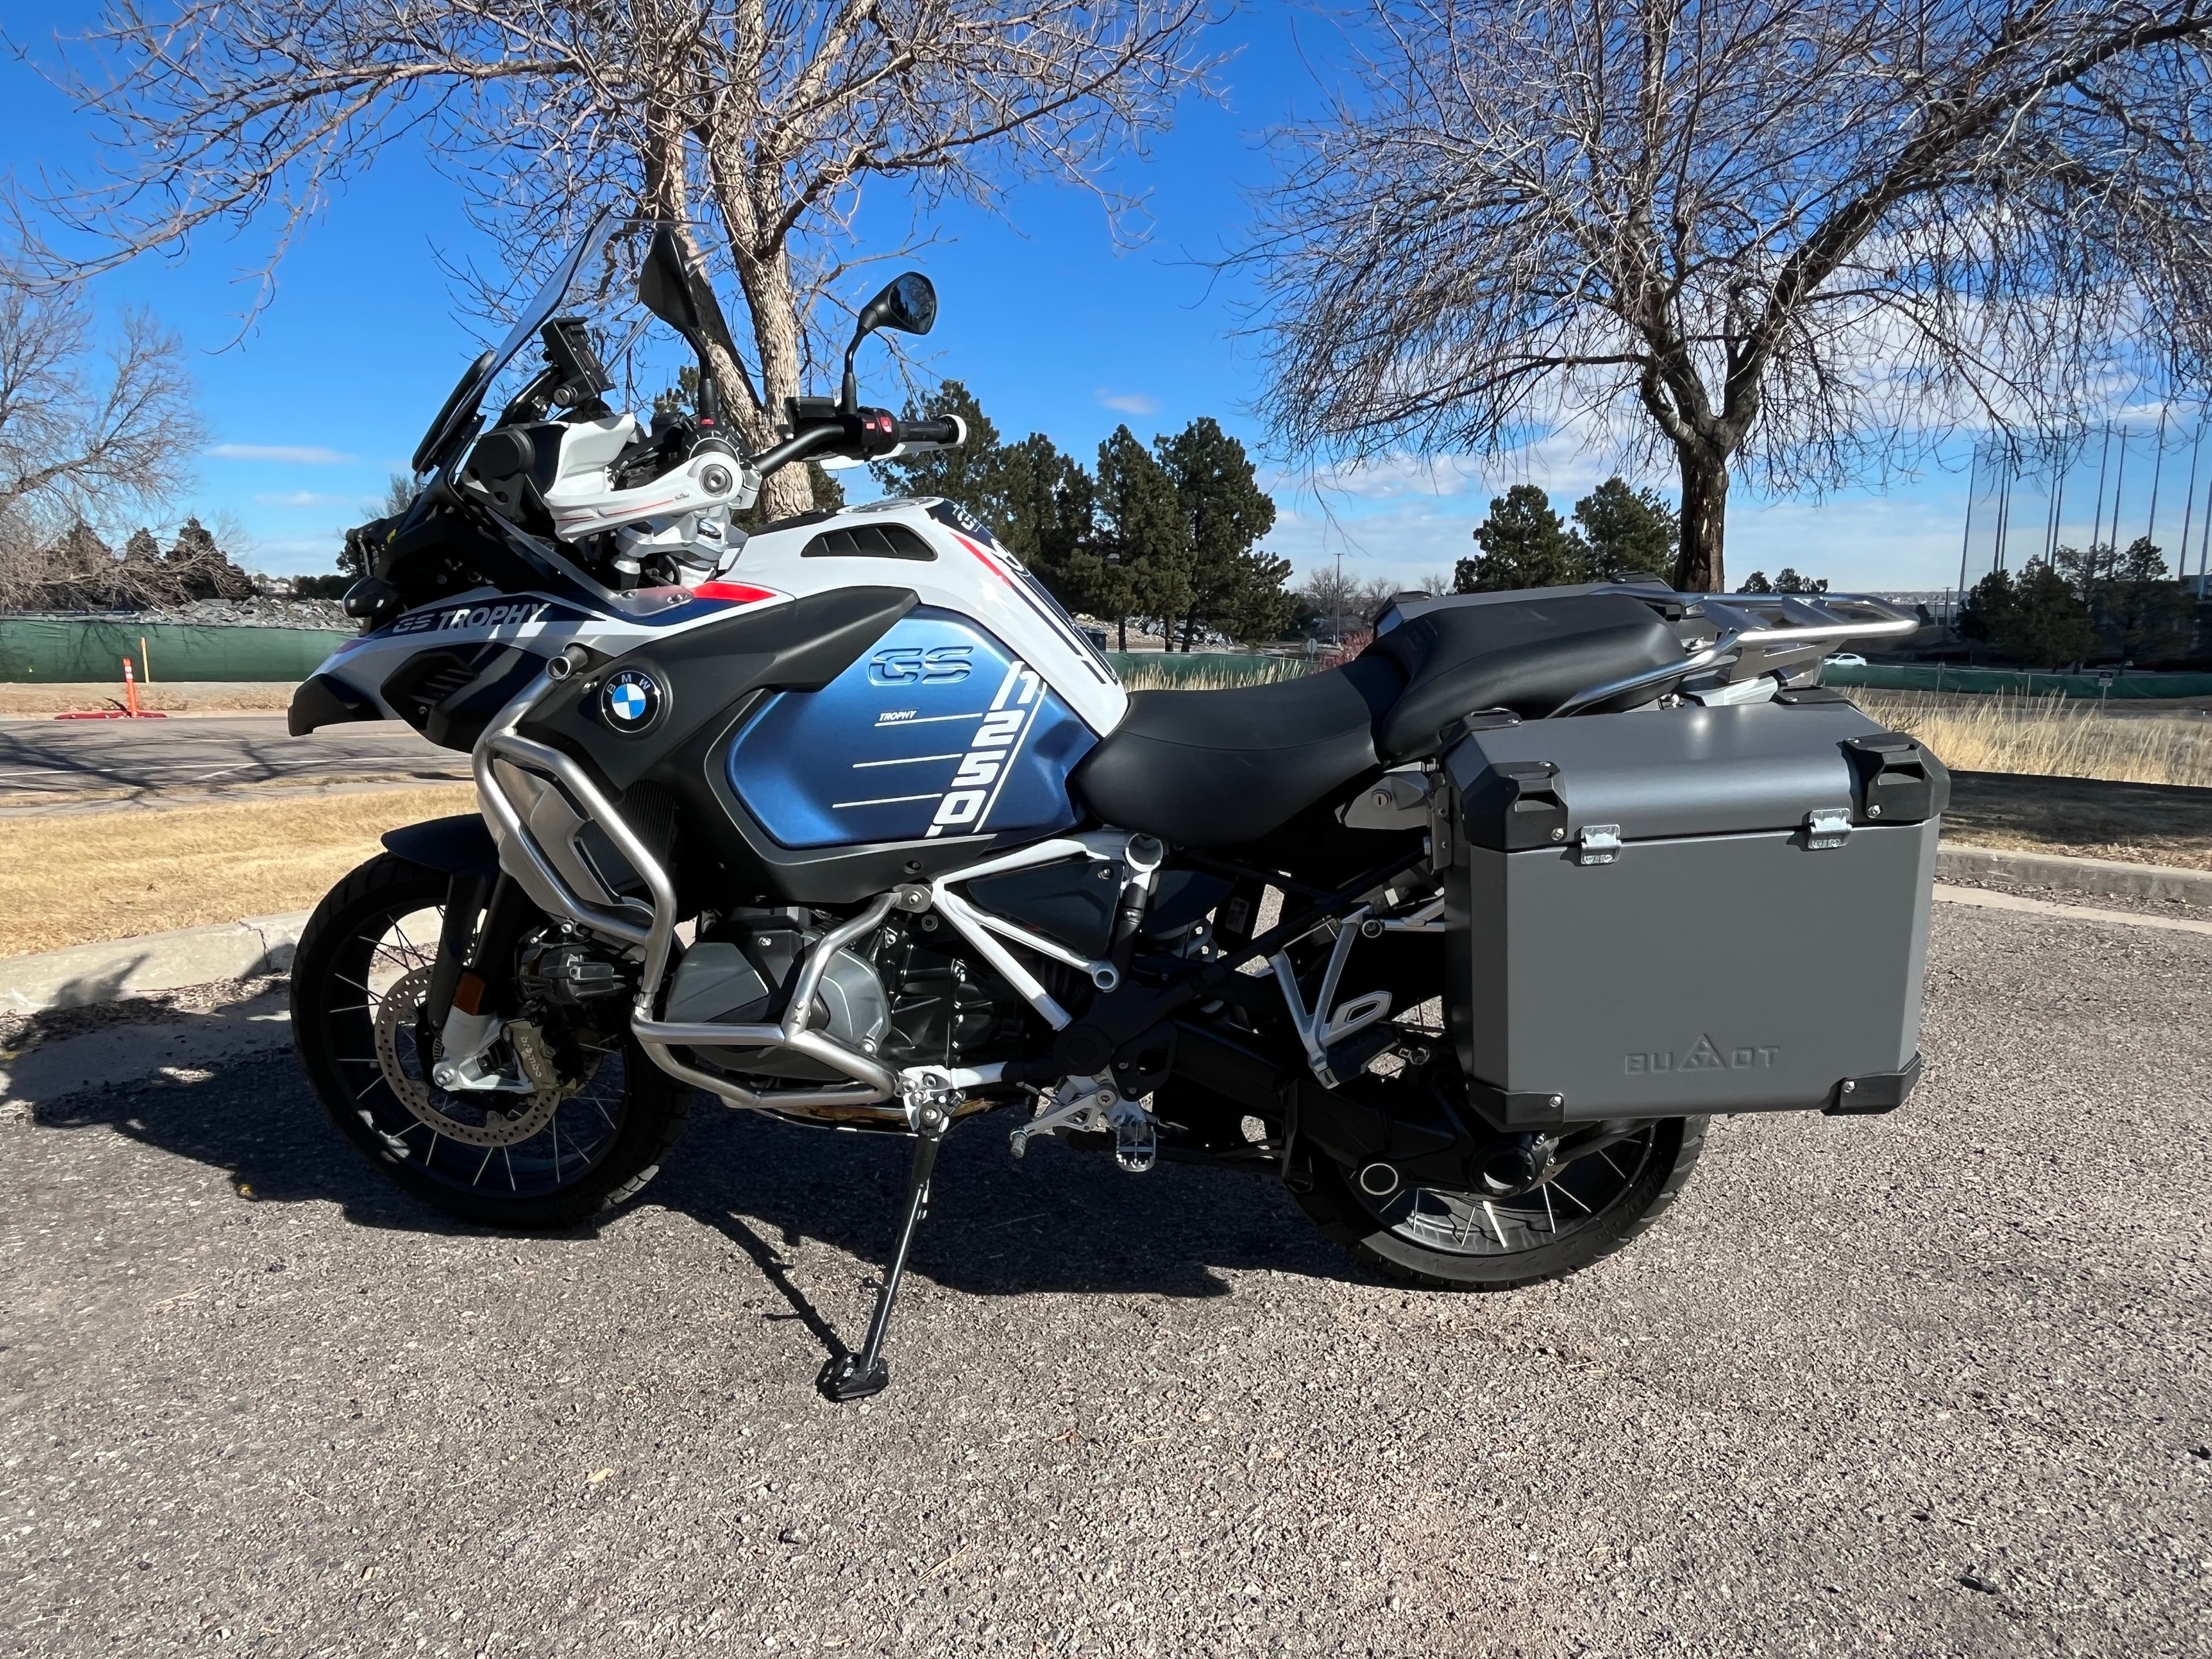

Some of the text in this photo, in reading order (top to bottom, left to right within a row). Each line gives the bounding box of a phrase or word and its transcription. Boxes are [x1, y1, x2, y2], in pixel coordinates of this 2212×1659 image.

[392, 603, 552, 633] GS TROPHY
[868, 646, 974, 686] GS
[606, 673, 651, 694] BMW
[879, 710, 918, 721] TROPHY
[933, 670, 1040, 824] 1250
